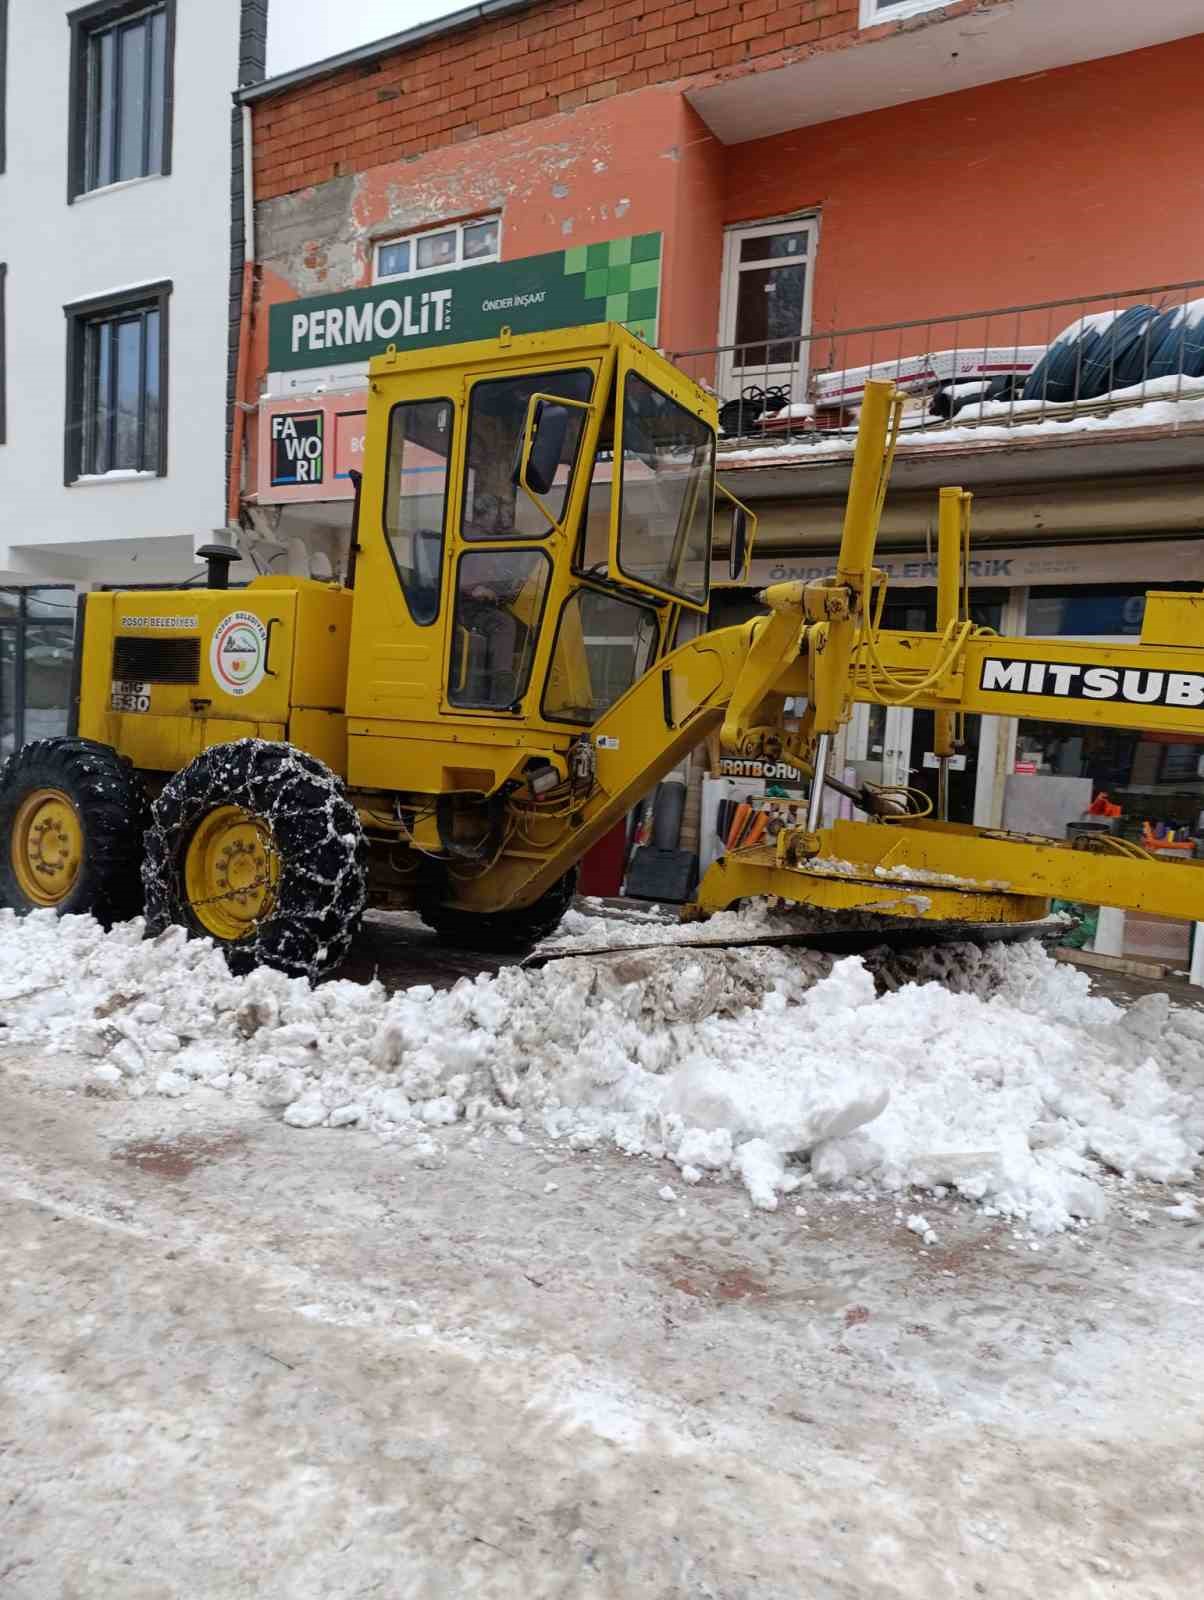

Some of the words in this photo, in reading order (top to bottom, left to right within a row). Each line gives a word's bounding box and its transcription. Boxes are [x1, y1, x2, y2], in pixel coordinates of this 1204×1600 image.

[272, 416, 297, 439] FA
[285, 436, 321, 460] WO
[982, 659, 1204, 707] MITSUB
